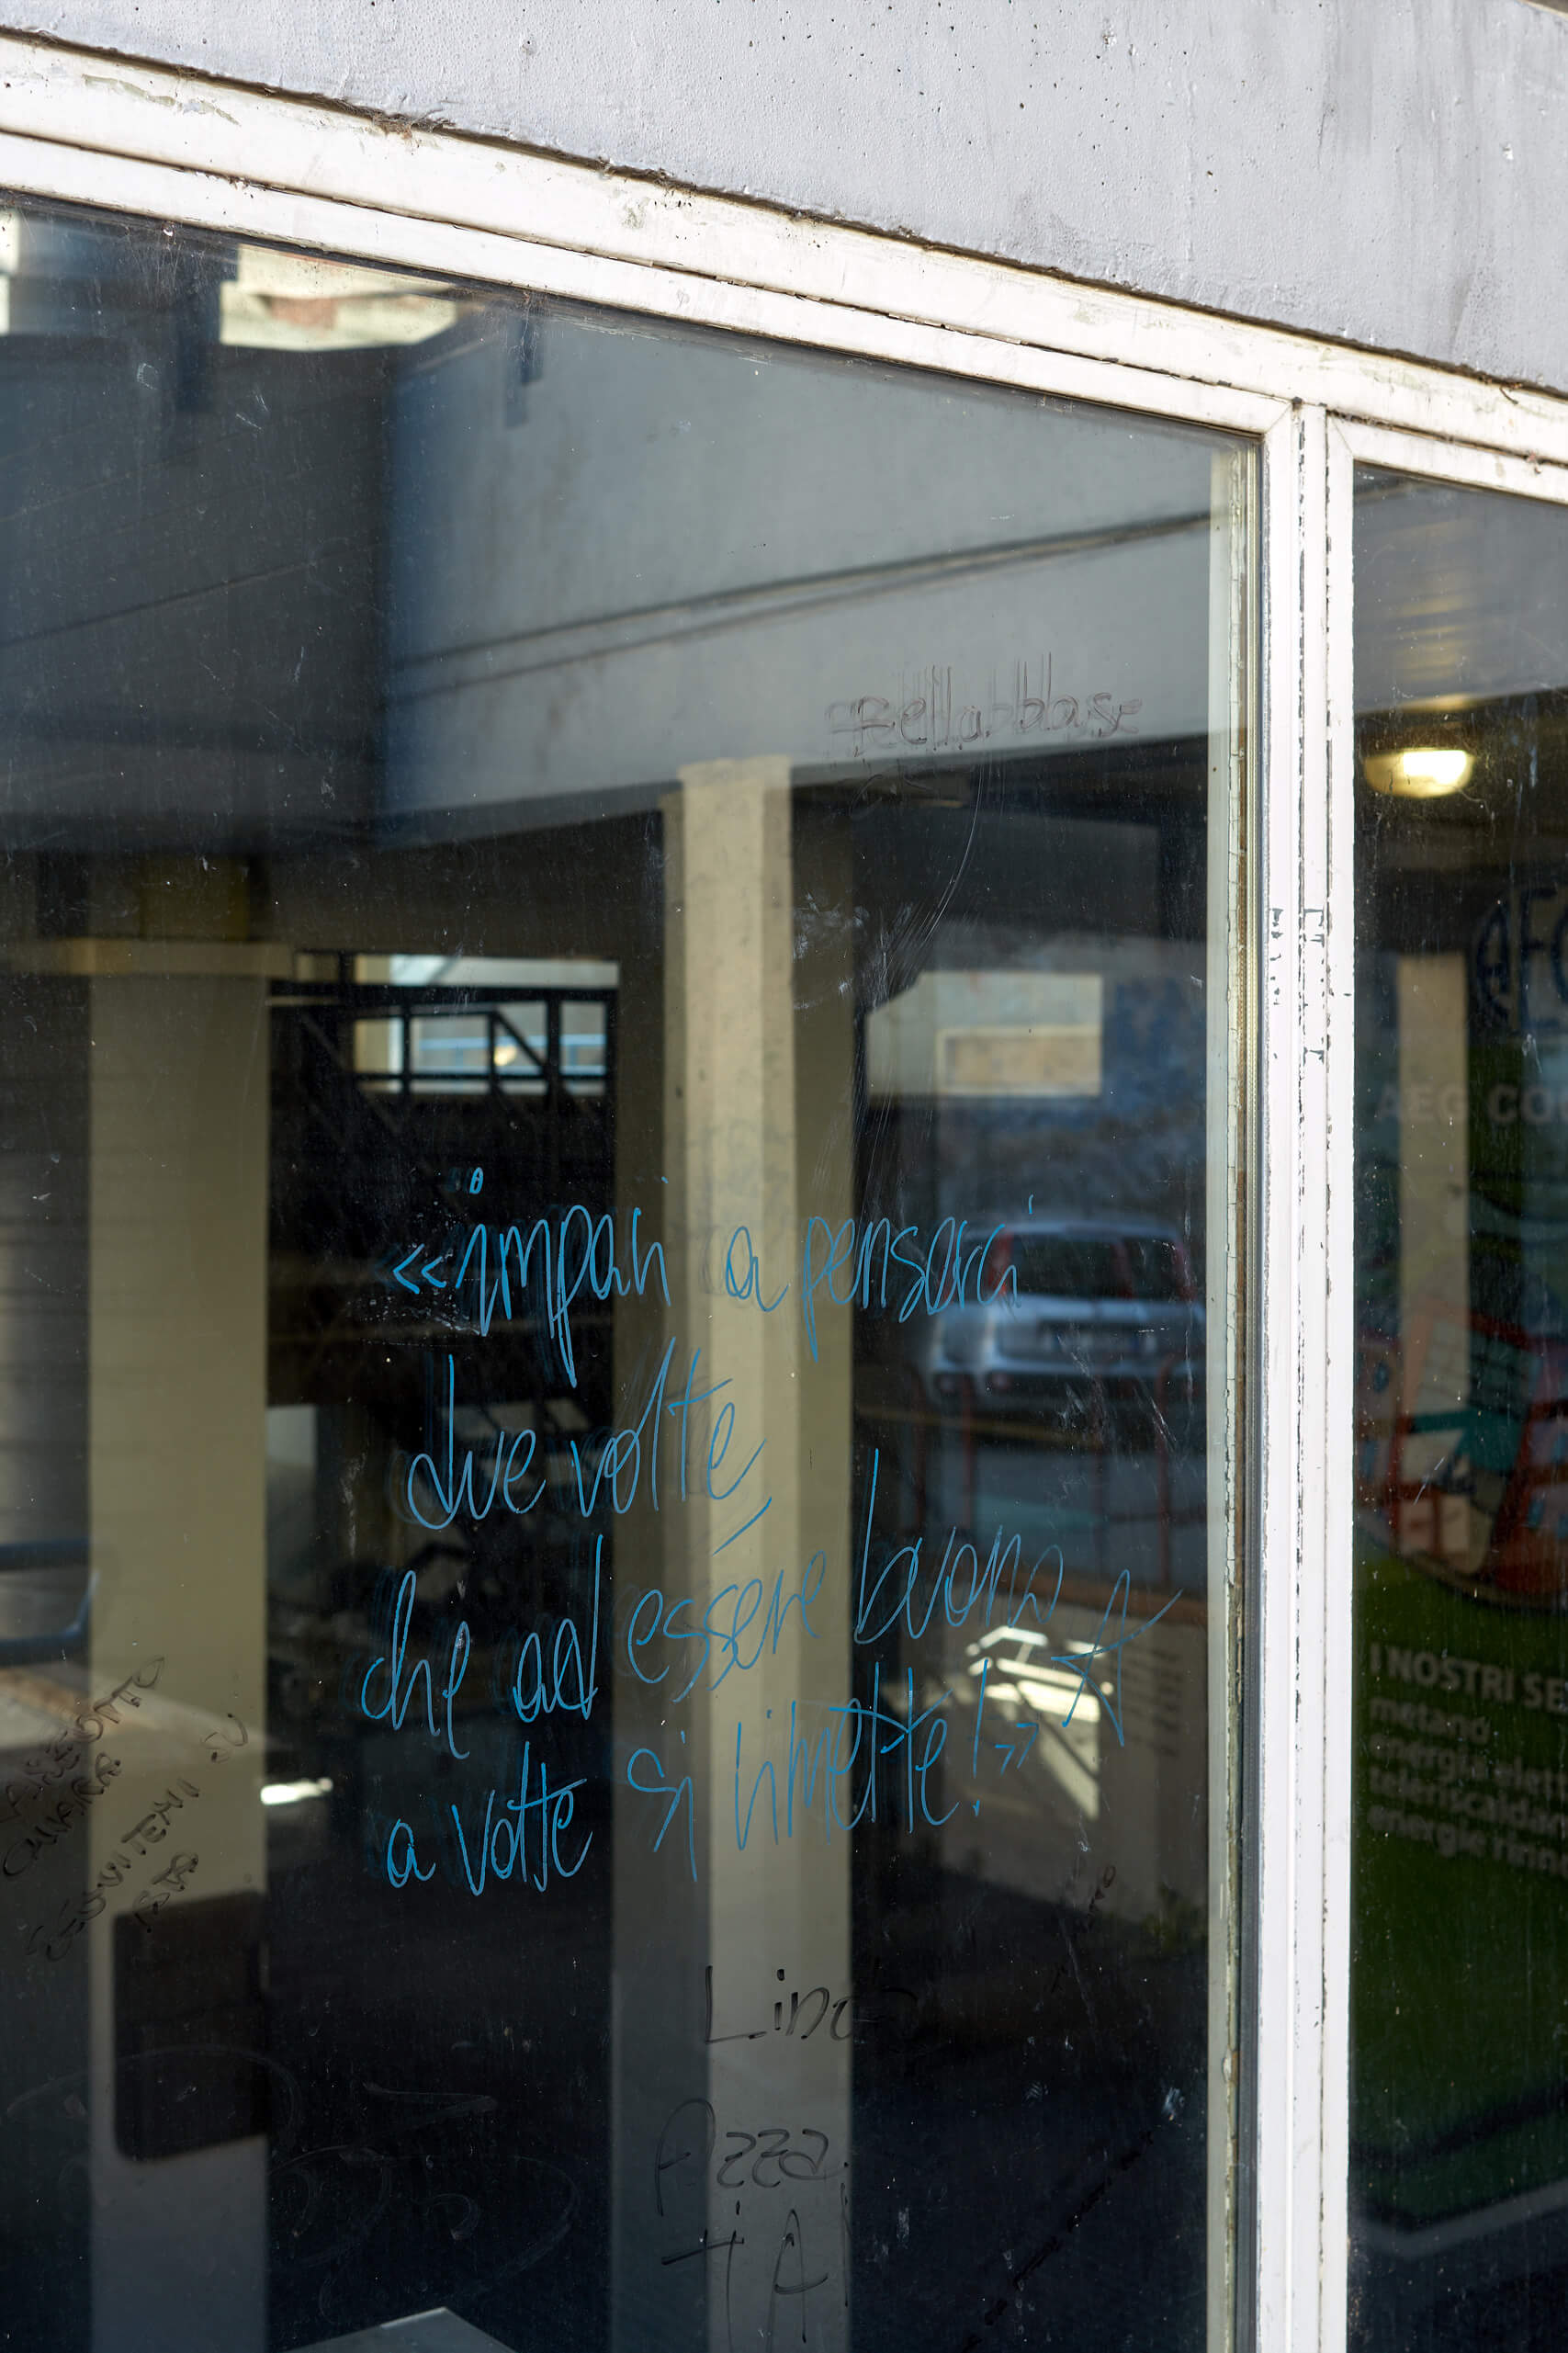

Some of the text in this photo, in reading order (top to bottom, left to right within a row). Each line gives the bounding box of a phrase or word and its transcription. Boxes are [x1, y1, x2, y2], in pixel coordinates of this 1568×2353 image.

[1485, 1083, 1568, 1124] CO
[725, 1225, 791, 1313] a
[1369, 1641, 1382, 1677] I
[1386, 1645, 1516, 1703] NOSTRI
[387, 1818, 436, 1889] a
